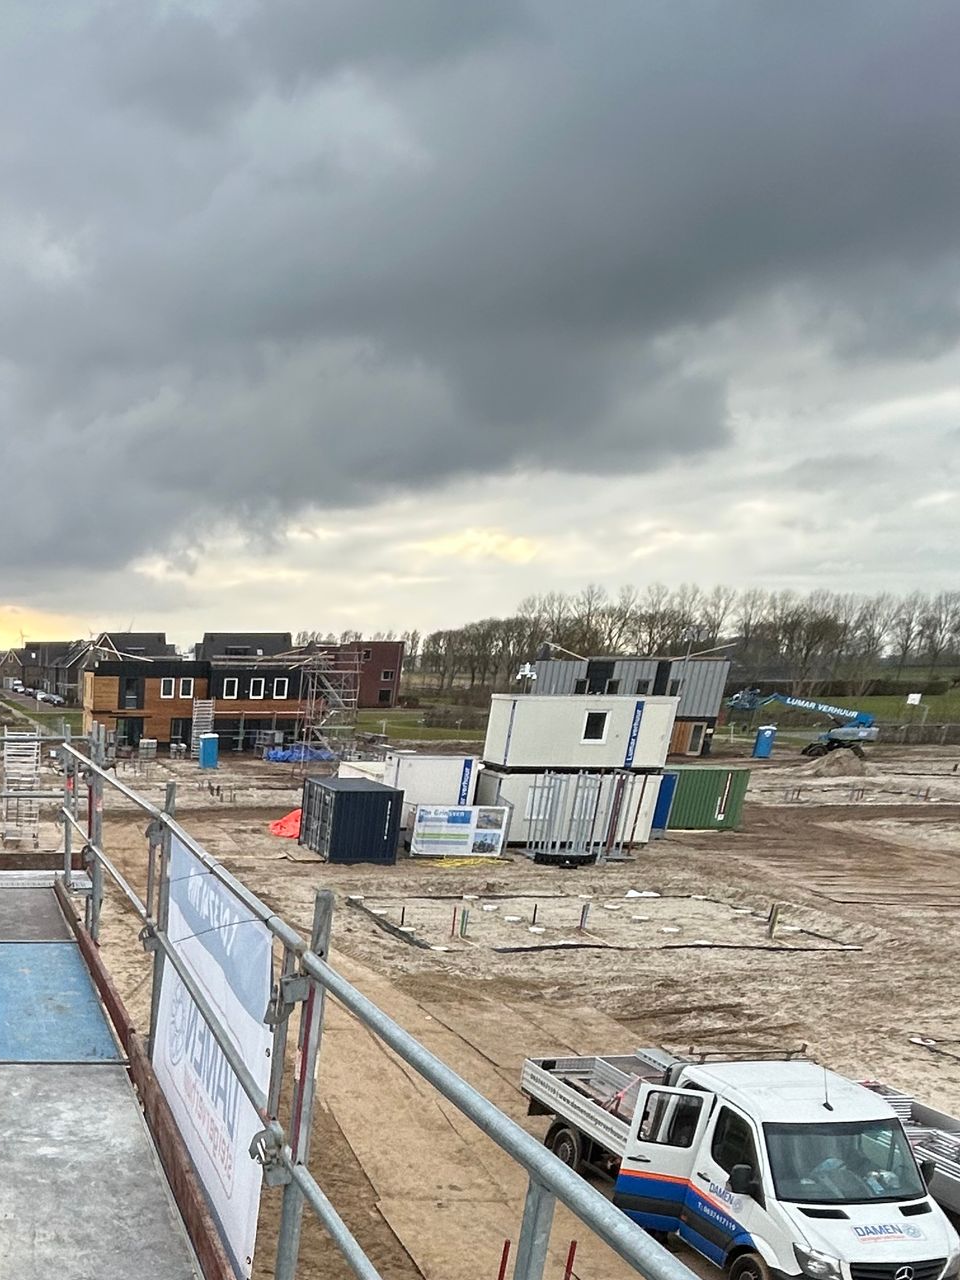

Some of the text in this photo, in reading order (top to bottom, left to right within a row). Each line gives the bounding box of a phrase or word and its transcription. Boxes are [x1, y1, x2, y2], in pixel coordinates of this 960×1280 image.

[786, 697, 859, 719] LUMAR VERHUUR
[709, 1182, 735, 1205] DAMEN
[853, 1224, 903, 1237] DAMEN
